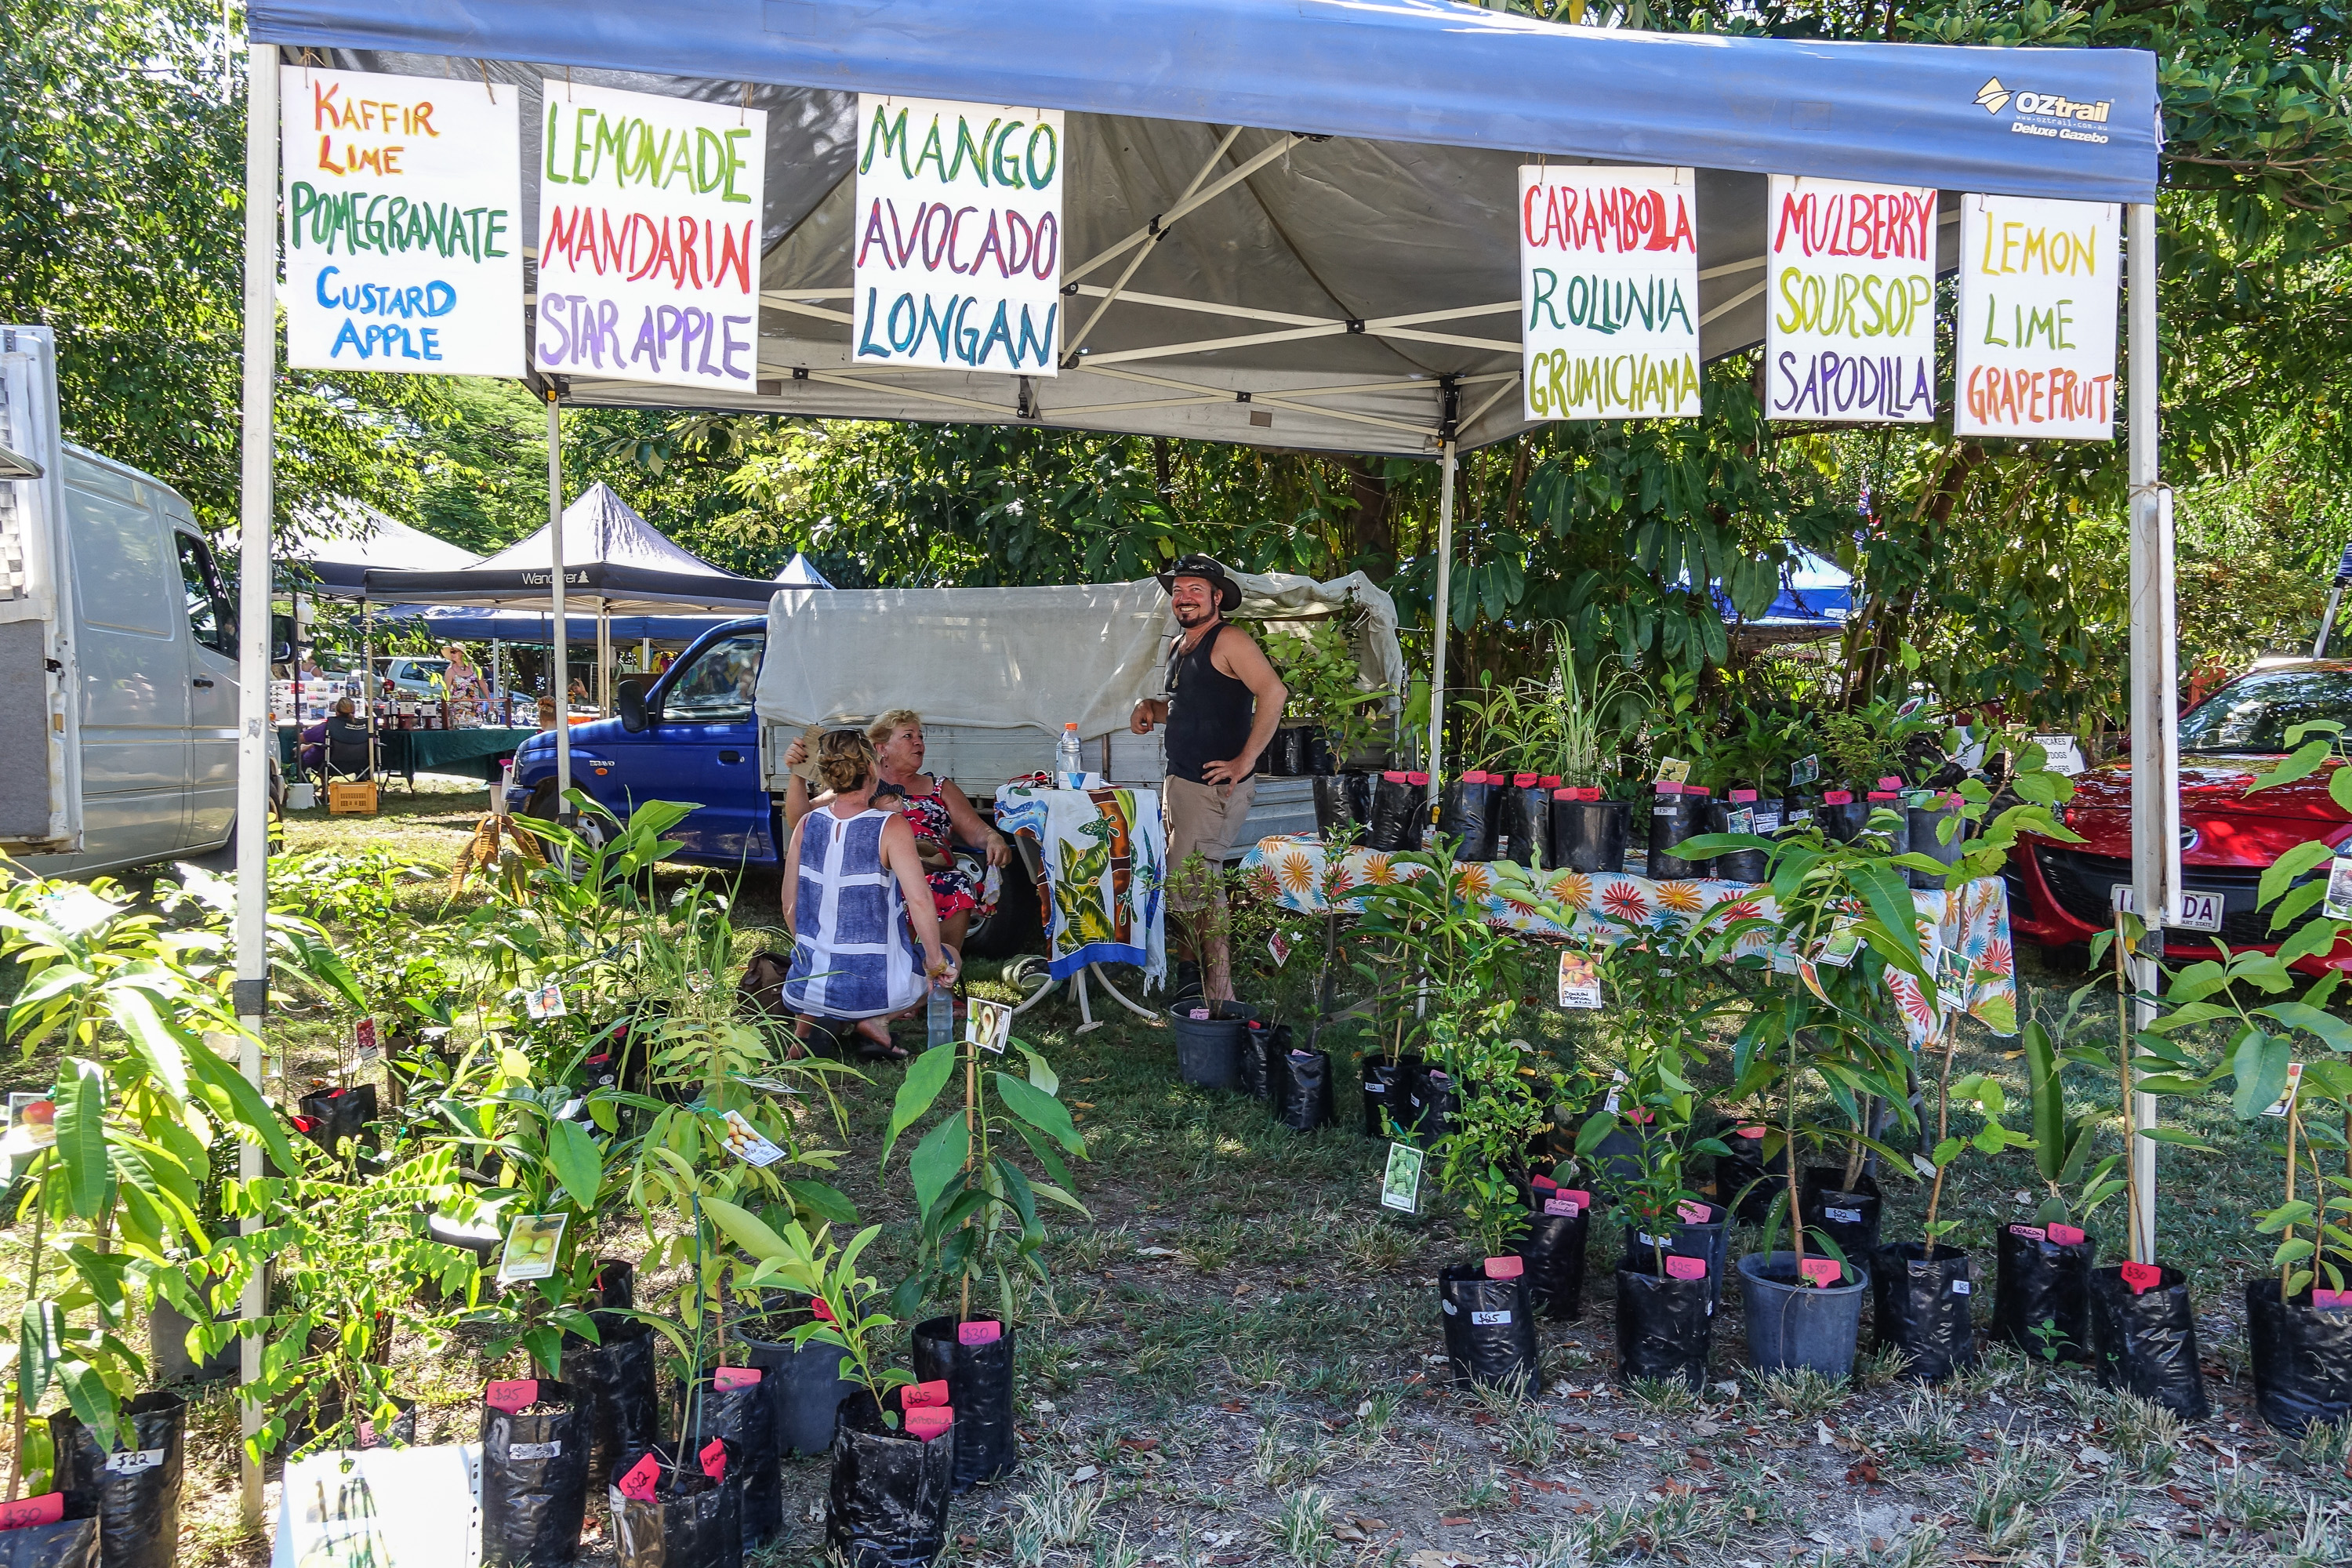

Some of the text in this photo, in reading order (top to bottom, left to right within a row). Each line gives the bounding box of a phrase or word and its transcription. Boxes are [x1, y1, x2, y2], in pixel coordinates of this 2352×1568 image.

[315, 80, 439, 136] KAFFIR
[2015, 91, 2111, 123] OZtrail
[2016, 114, 2108, 131] www.oztrail.com.au
[546, 101, 750, 204] LEMONADE
[859, 104, 1057, 190] MANGO
[2012, 122, 2109, 144] Deluxe Gazebo
[319, 136, 405, 176] LIME
[292, 182, 508, 263] POMEGRANATE
[857, 197, 1057, 280] AVOCADO
[1524, 185, 1696, 253] CARAMBOLA
[1774, 190, 1936, 261] MULBERRY
[542, 205, 753, 294] MANDARIN
[1981, 212, 2096, 276] LEMON
[317, 267, 456, 317] CUSTARD
[1529, 268, 1693, 335] ROLLINIA
[1776, 267, 1932, 338] SOURSOP
[331, 318, 442, 360] APPLE
[539, 293, 751, 380] STAR APPLE
[858, 287, 1057, 369] LONGAN
[1984, 293, 2076, 350] LIME
[1529, 348, 1700, 418] GRUMICHAMA
[1774, 351, 1933, 418] SAPODILLA
[1967, 365, 2113, 426] GRAPEFRUIT
[2012, 1225, 2043, 1236] DRAGON
[2053, 1228, 2067, 1241] $8
[1490, 1261, 1512, 1274] $25
[1670, 1261, 1693, 1274] $25
[1806, 1262, 1828, 1276] $30
[2125, 1266, 2148, 1280] $30
[964, 1327, 989, 1341] $30
[1479, 1313, 1501, 1324] $25
[493, 1386, 525, 1403] $25
[906, 1391, 932, 1406] $25
[906, 1415, 950, 1425] SAPODILLA
[118, 1453, 150, 1469] $22
[627, 1471, 651, 1497] $22
[2, 1507, 42, 1529] $30
